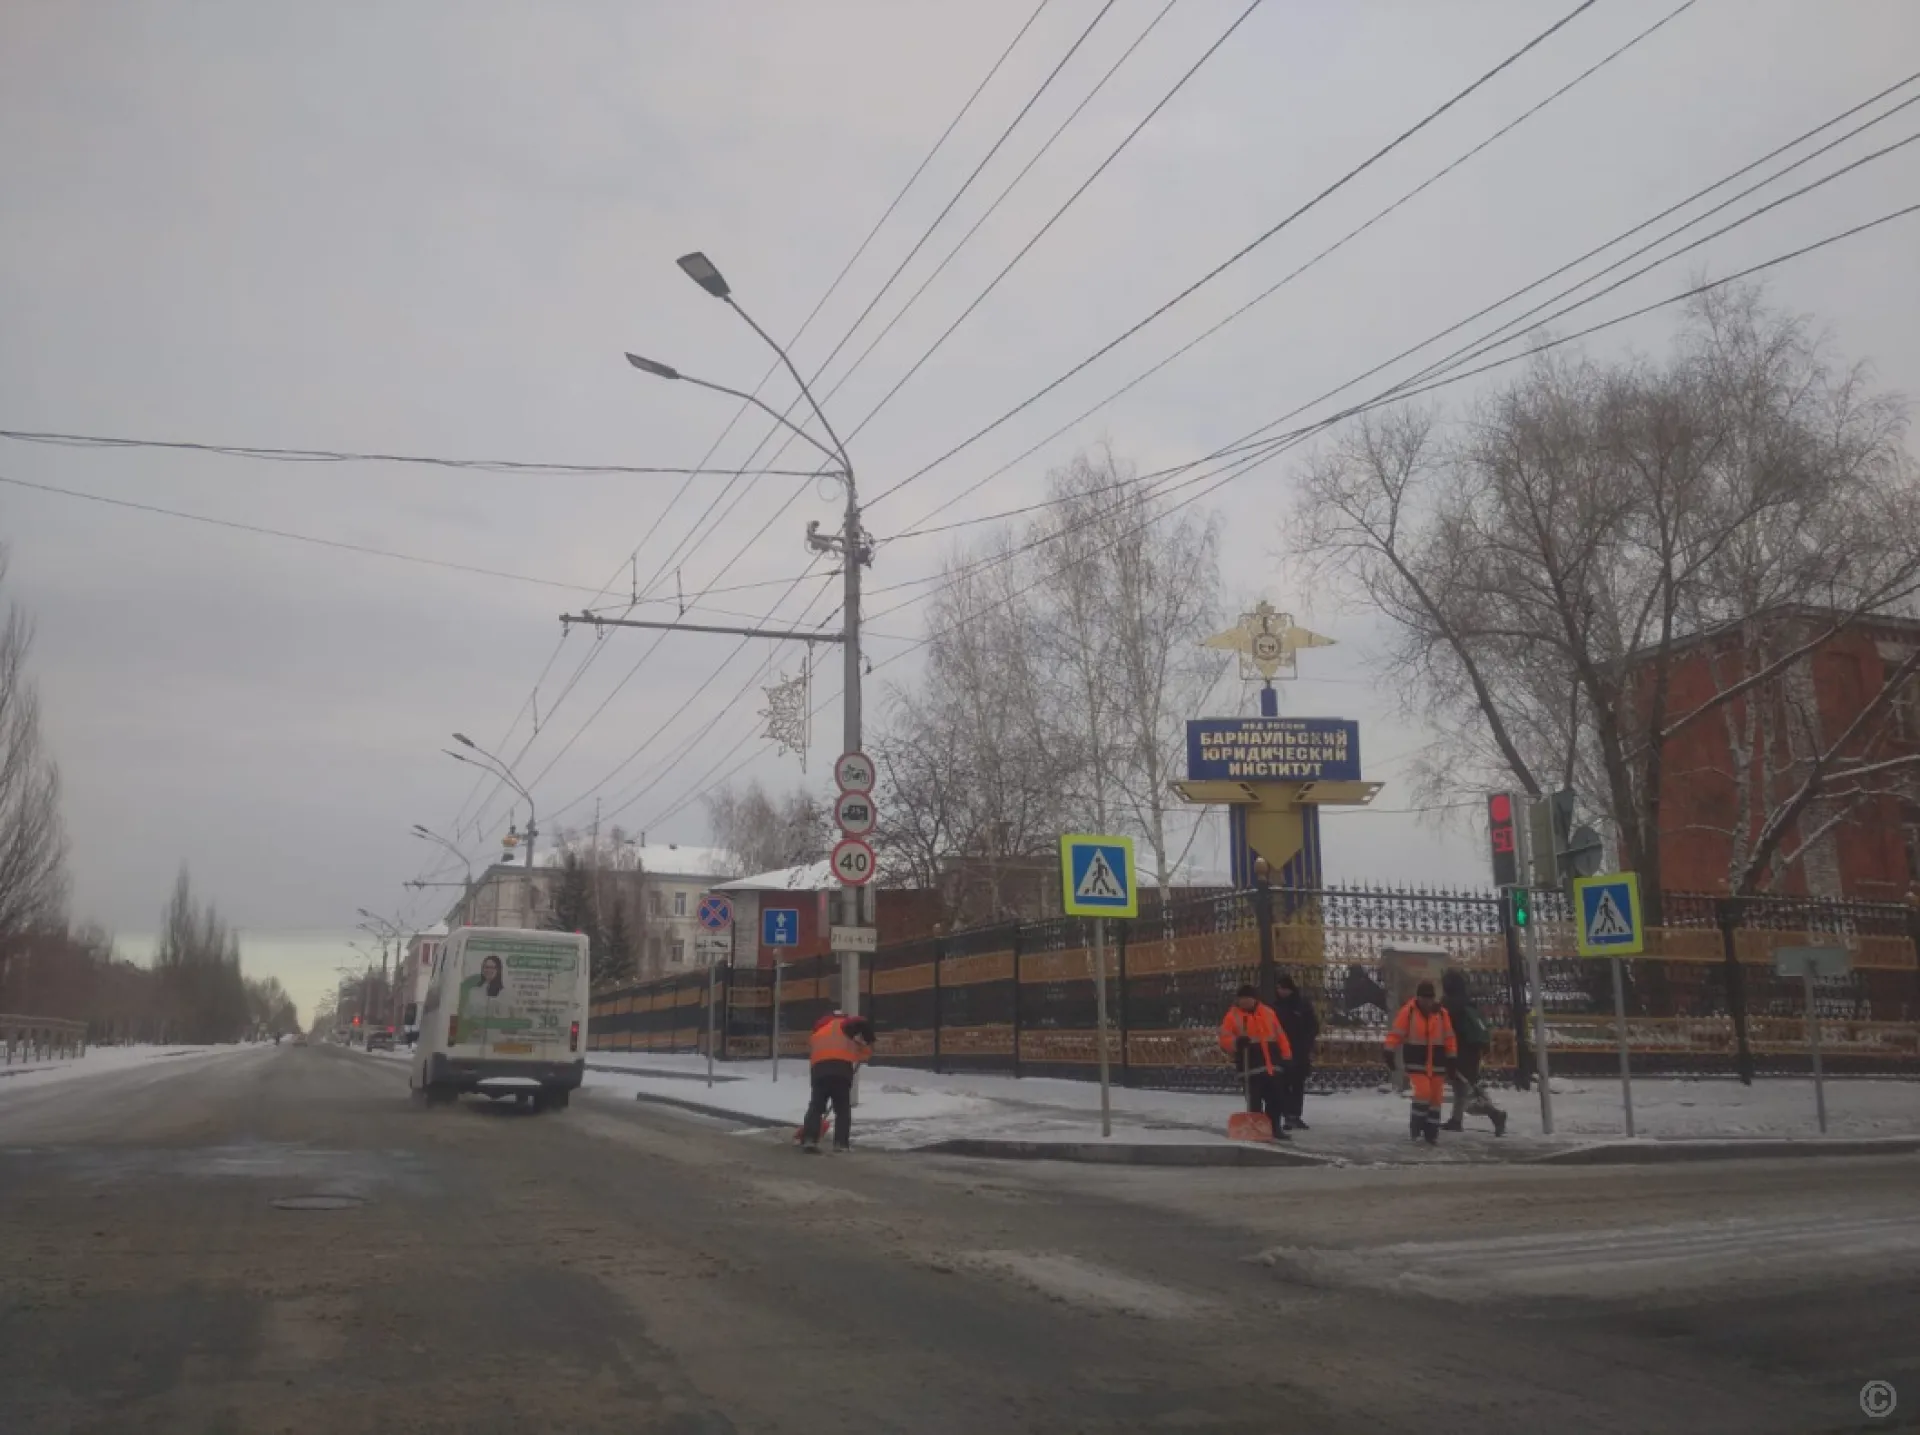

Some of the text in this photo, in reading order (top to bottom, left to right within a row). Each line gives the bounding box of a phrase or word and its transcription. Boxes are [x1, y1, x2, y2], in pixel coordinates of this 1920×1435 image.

[1200, 729, 1348, 745] БАРНАУЛЬСКИЙ
[1202, 746, 1347, 762] ЮРИДИЧЕСКИЙ
[1229, 762, 1324, 776] ИНСТИТУТ
[839, 853, 867, 872] 40
